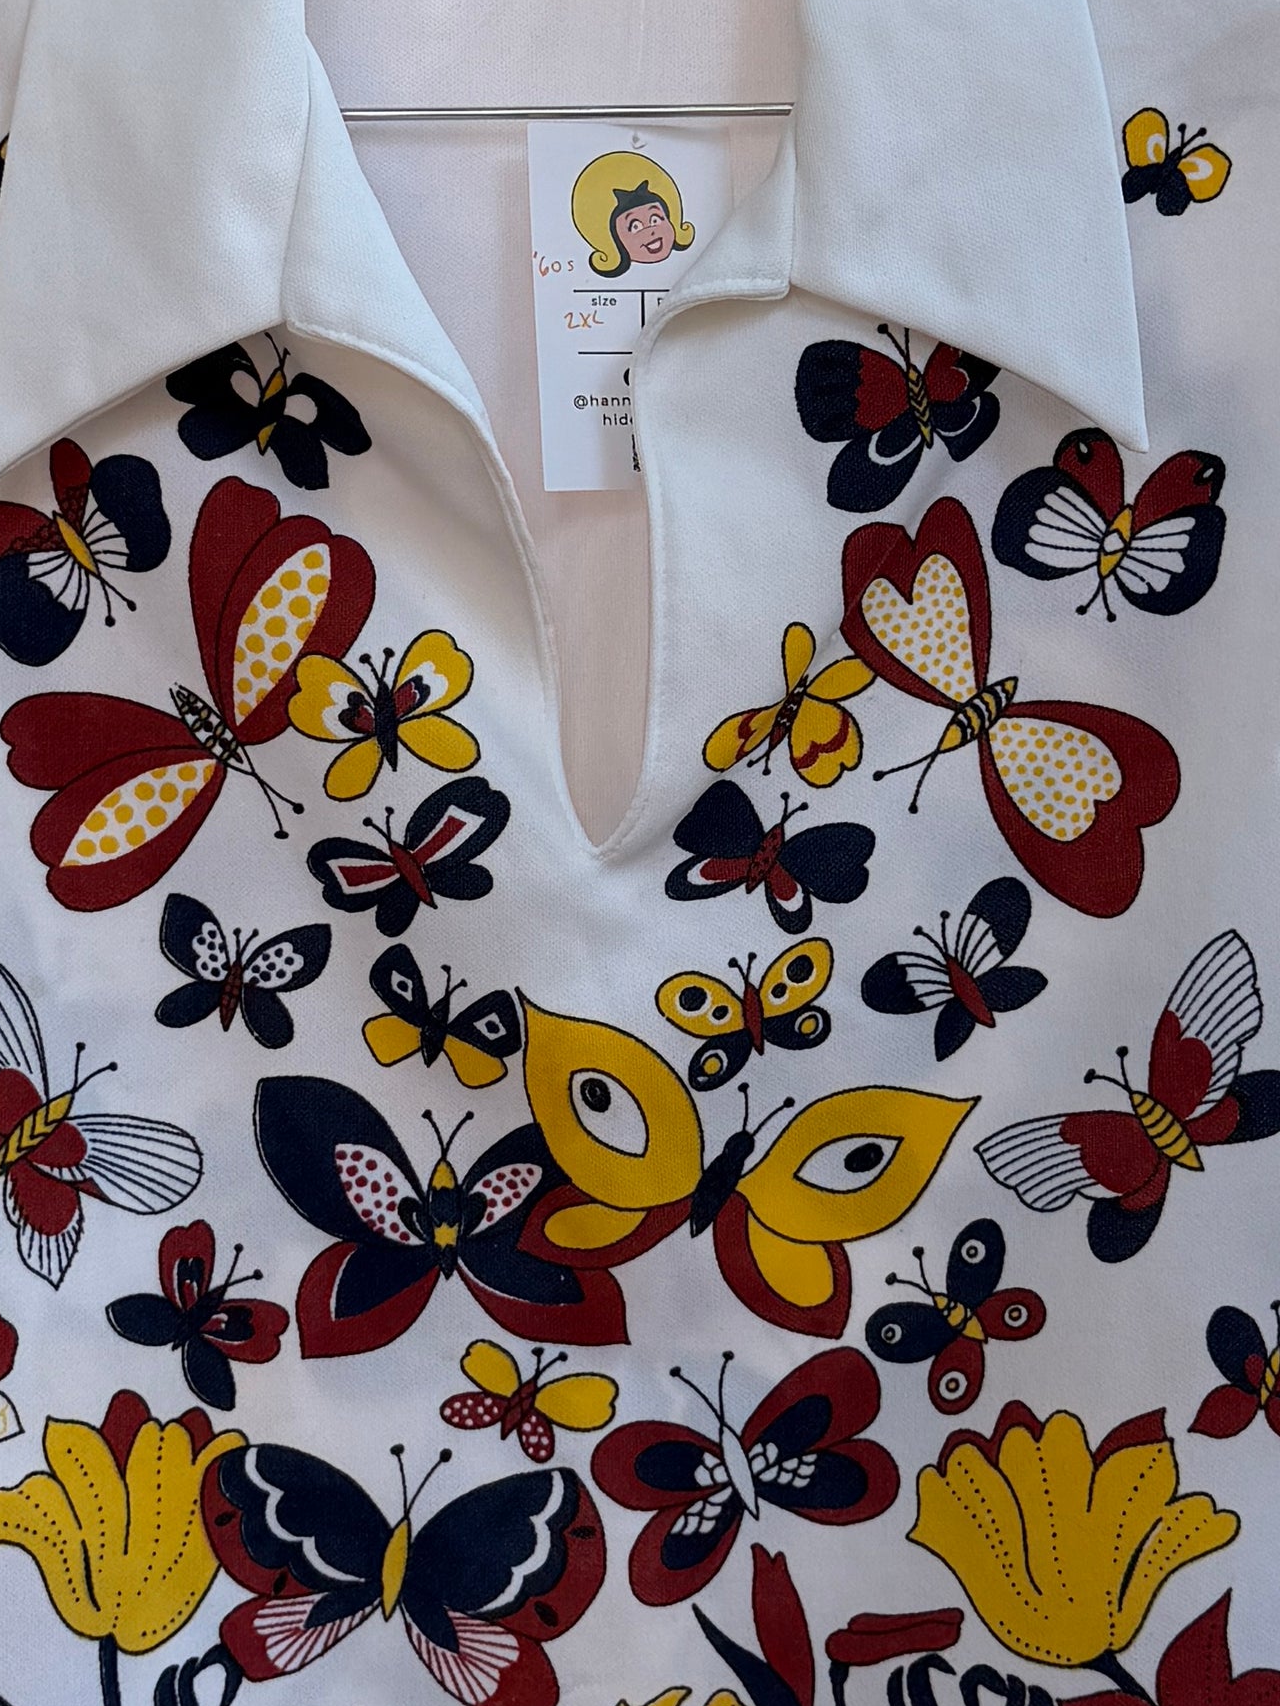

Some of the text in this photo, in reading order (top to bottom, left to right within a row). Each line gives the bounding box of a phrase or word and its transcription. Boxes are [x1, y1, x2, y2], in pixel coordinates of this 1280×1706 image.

[591, 295, 617, 306] size
[564, 310, 604, 329] 2XL
[602, 413, 633, 425] hid
